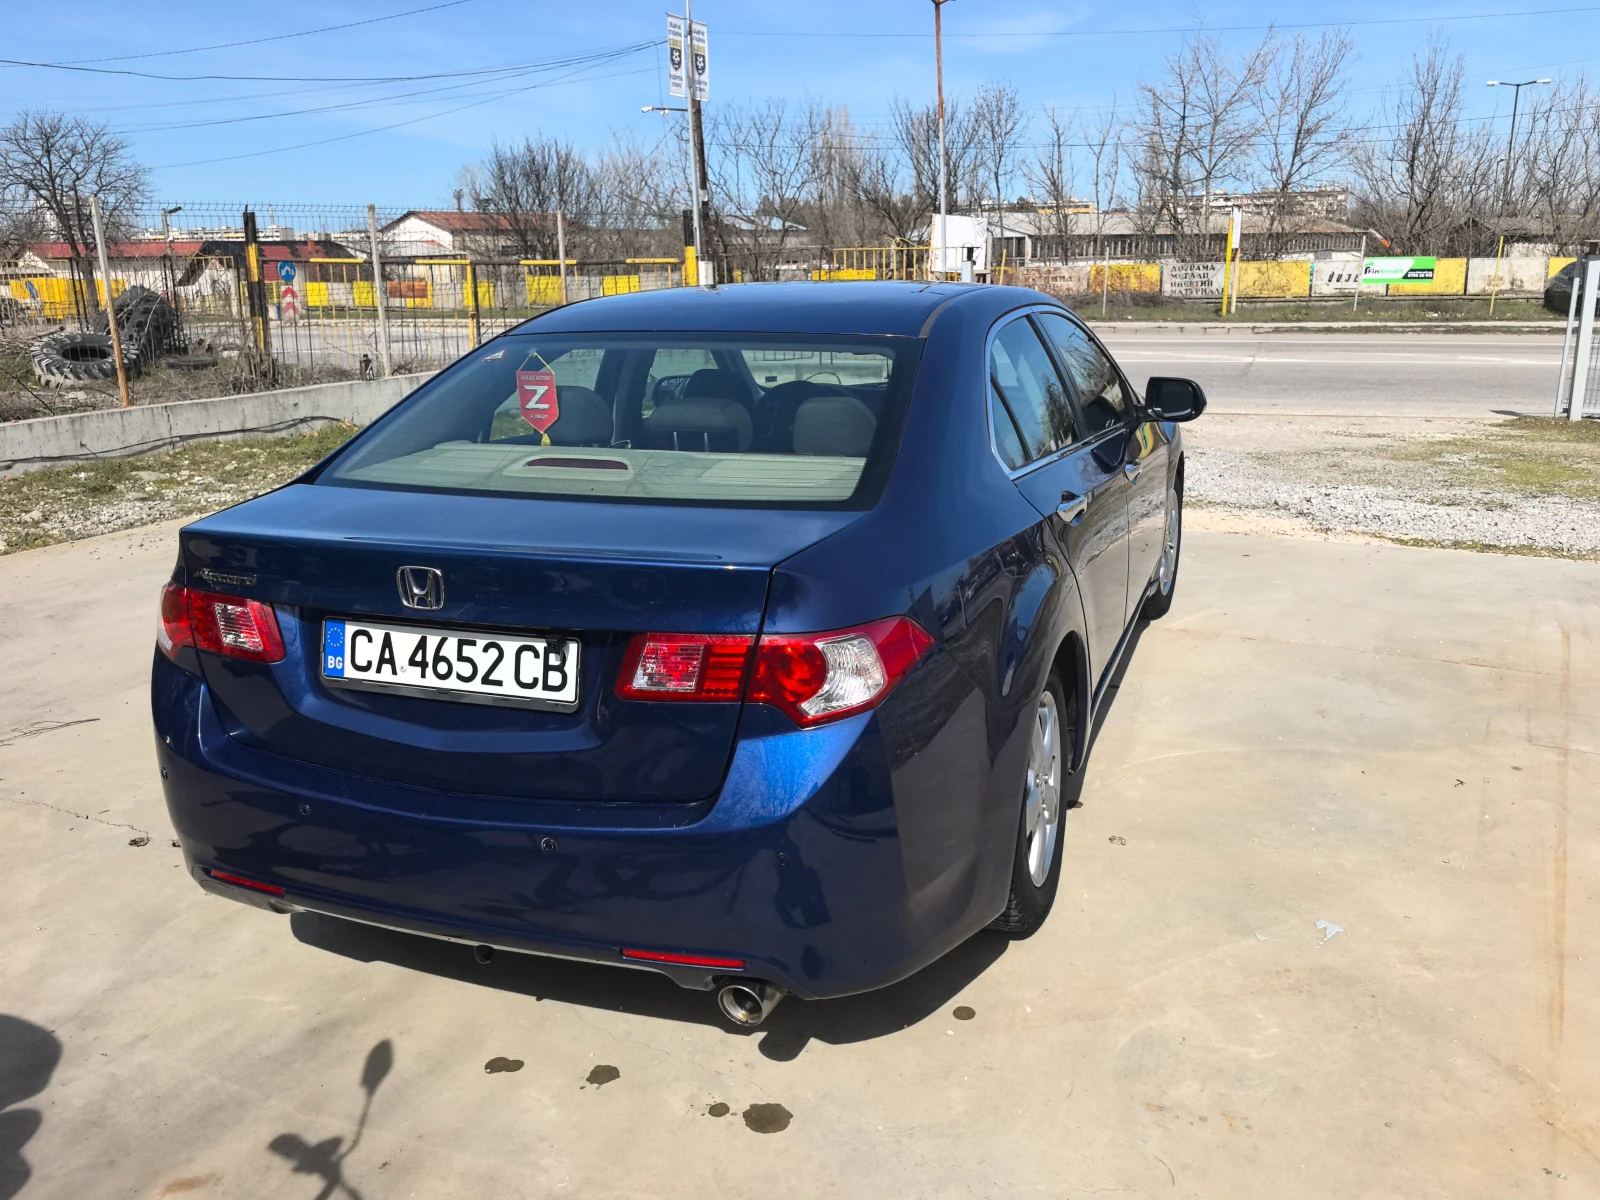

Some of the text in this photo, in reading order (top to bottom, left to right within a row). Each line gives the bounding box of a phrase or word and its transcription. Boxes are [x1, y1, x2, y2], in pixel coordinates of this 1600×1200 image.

[1366, 267, 1403, 275] FinKredit
[523, 385, 550, 409] Z
[327, 655, 344, 670] BG
[350, 628, 398, 676] CA
[408, 635, 505, 687] 4652
